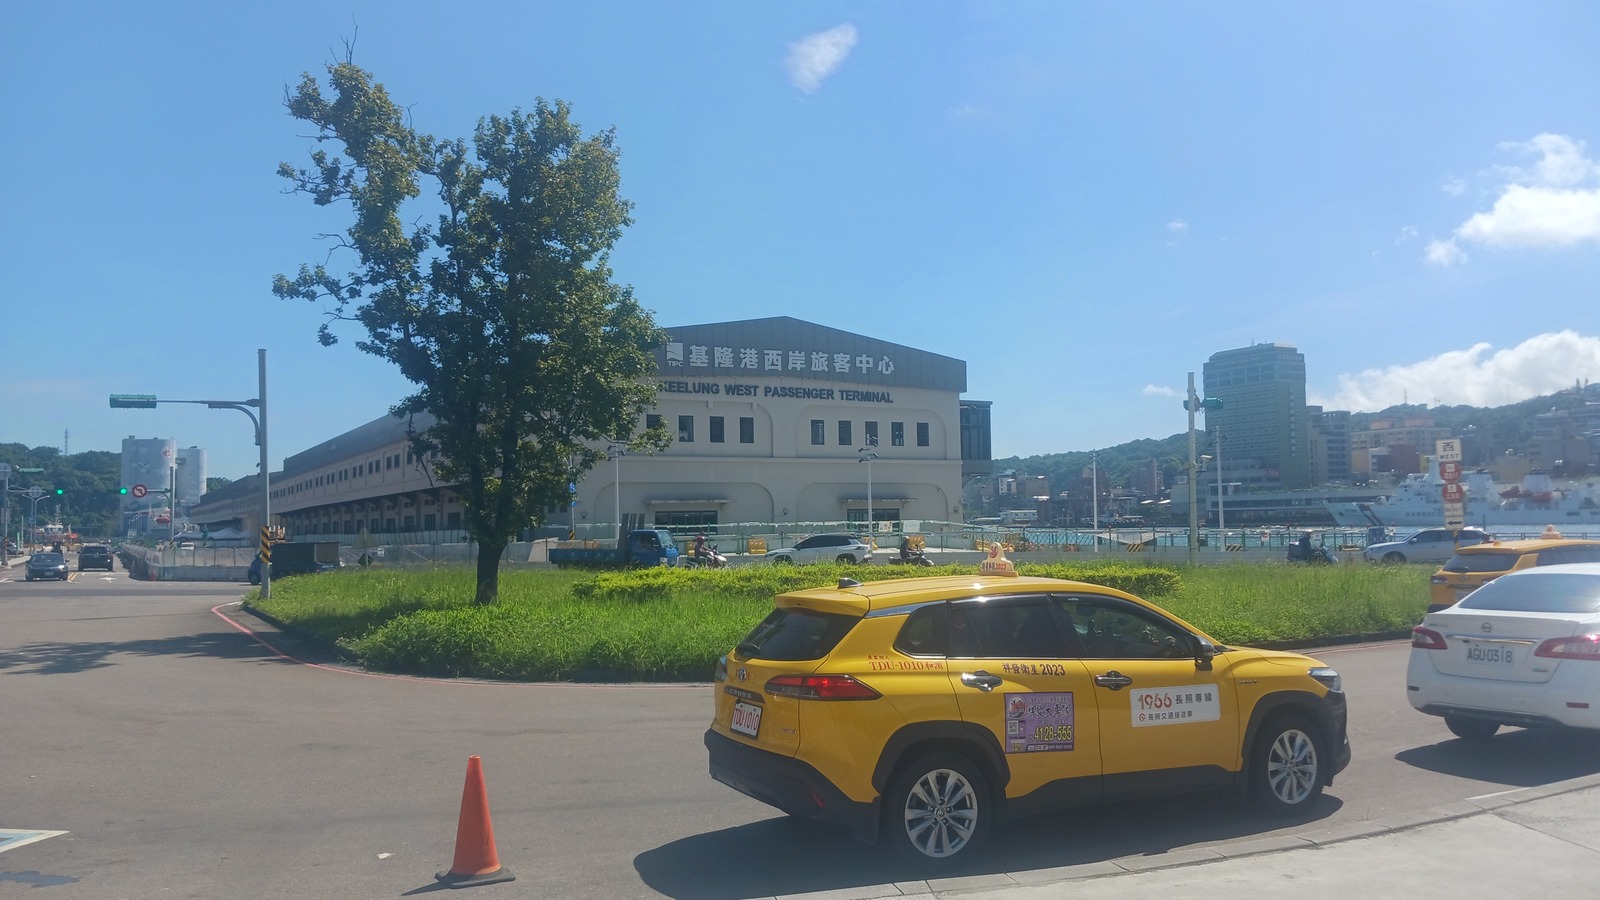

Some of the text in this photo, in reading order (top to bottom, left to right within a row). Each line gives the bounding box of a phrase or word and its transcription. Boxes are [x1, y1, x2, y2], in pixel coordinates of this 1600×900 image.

[689, 344, 896, 375] 基隆港西岸旅客中心
[659, 381, 894, 403] KEELUNG WEST PASSENGER TERMINAL
[1442, 441, 1455, 452] 西
[869, 660, 924, 671] TDU-1010
[1039, 663, 1066, 676] 2023
[729, 688, 752, 699] CROSS
[1138, 692, 1213, 710] 1966 長照專線
[1148, 710, 1193, 721] 長照交通接送車
[1034, 725, 1072, 741] 4128-555
